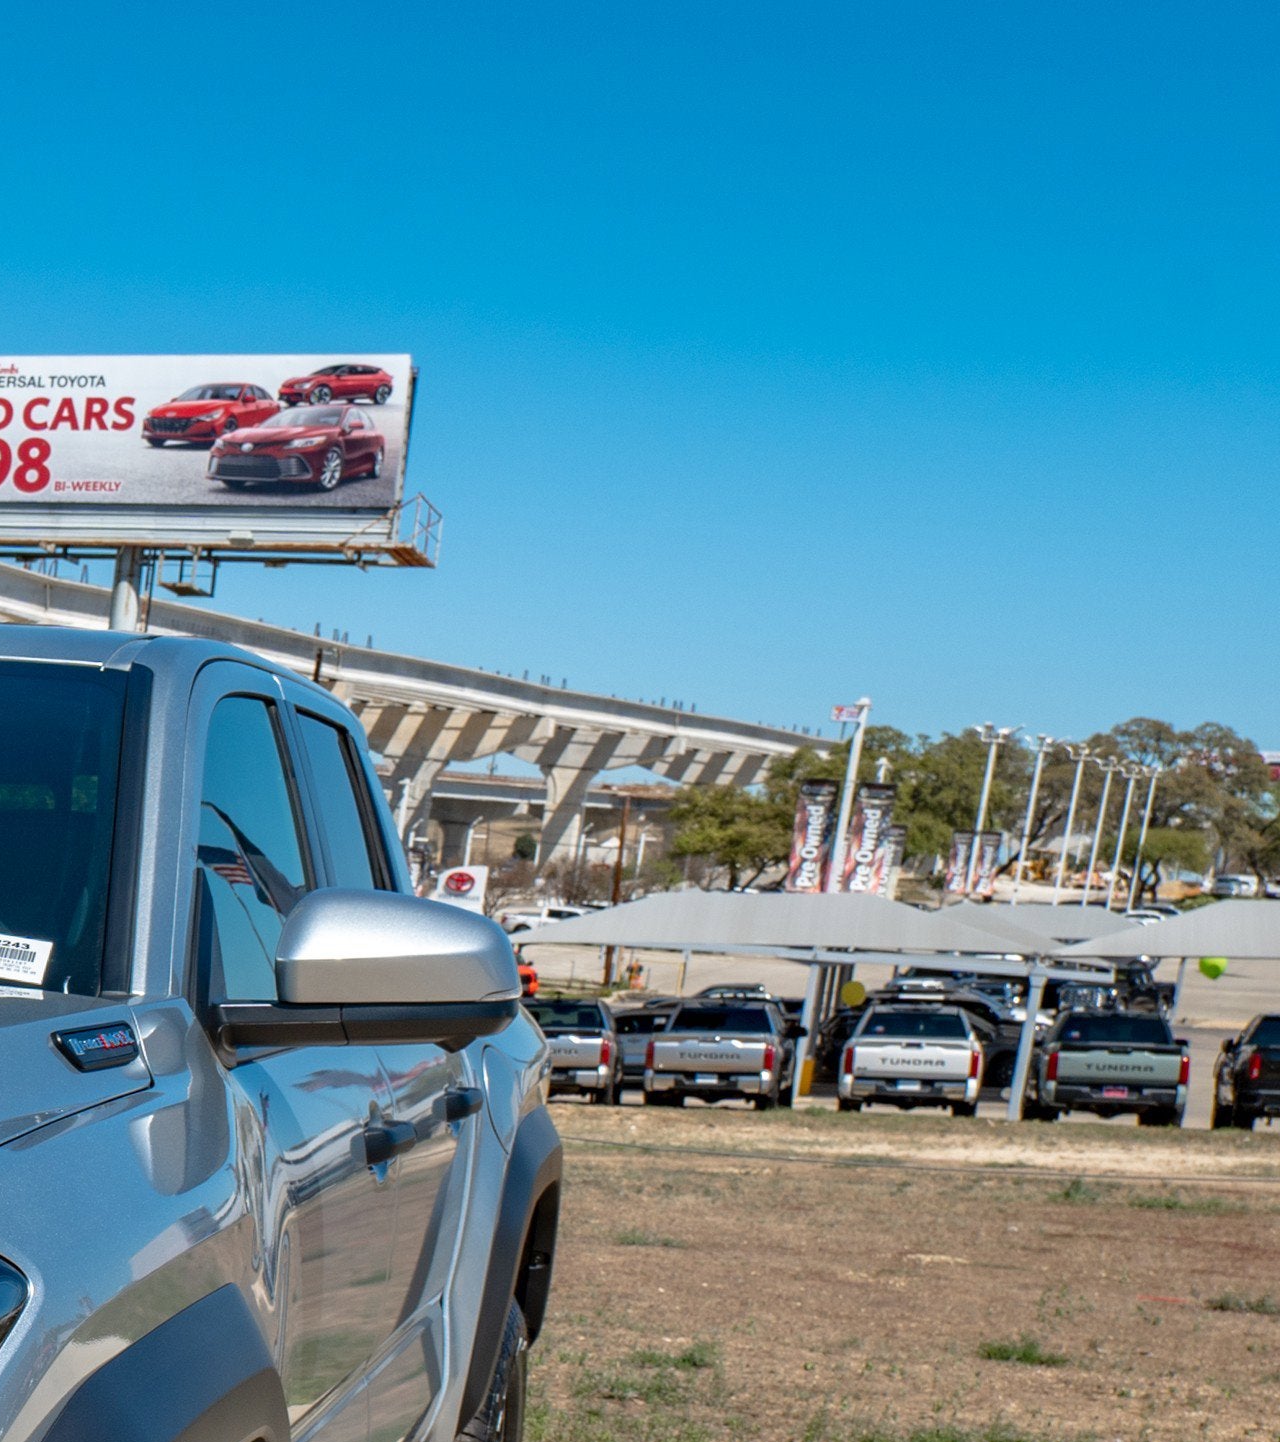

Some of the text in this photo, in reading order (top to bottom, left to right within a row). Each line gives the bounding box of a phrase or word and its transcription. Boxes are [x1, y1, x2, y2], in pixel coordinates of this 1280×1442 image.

[48, 375, 107, 389] TOYOTA
[23, 395, 136, 431] CARS
[54, 480, 122, 493] BI-WEEKLY
[800, 804, 826, 860] Owned
[854, 808, 882, 862] Owned
[795, 862, 817, 888] Pre
[849, 864, 872, 891] Pre
[879, 1057, 946, 1068] TUNDRA
[1084, 1062, 1155, 1073] TUNDRA
